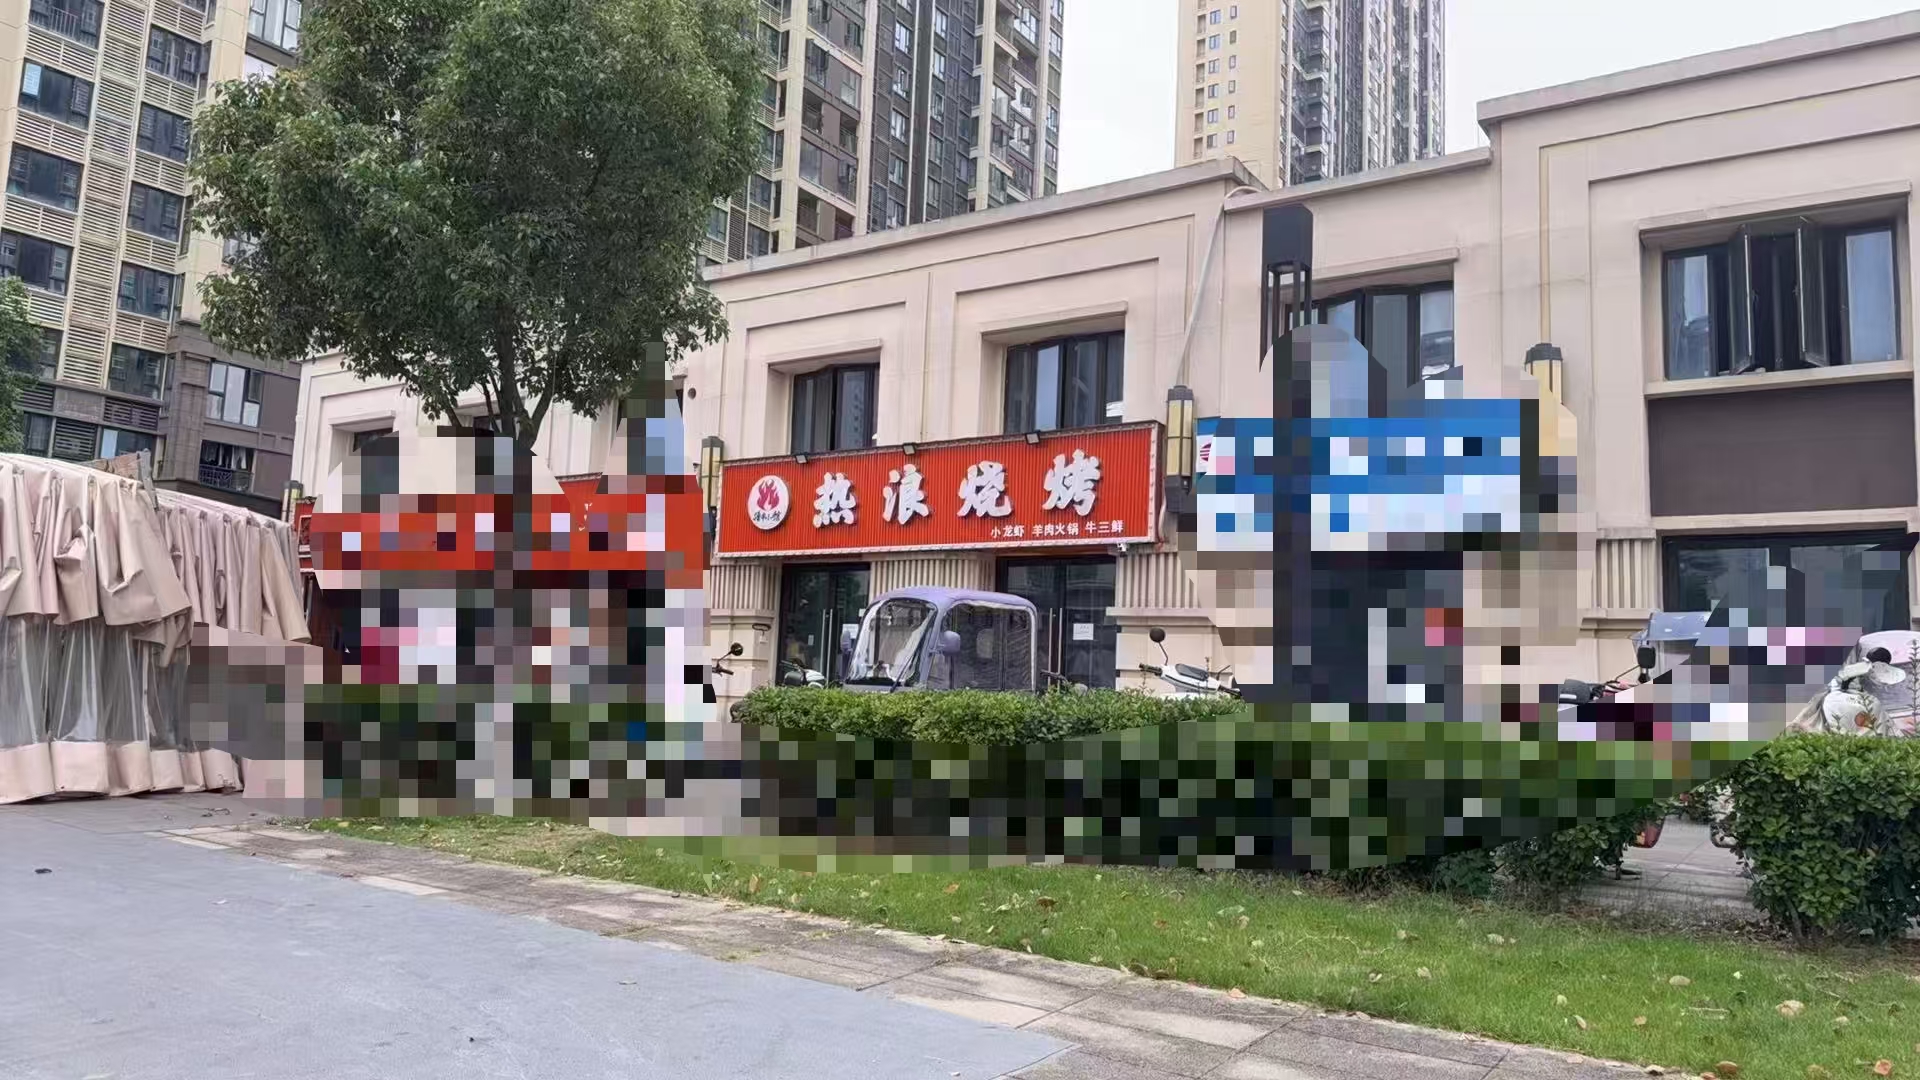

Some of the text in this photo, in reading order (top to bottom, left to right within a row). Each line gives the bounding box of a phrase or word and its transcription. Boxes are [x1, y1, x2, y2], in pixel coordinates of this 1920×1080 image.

[813, 449, 1100, 528] 热浪烧烤
[991, 520, 1124, 538] 小龙虾 羊肉火锅 牛三鲜
